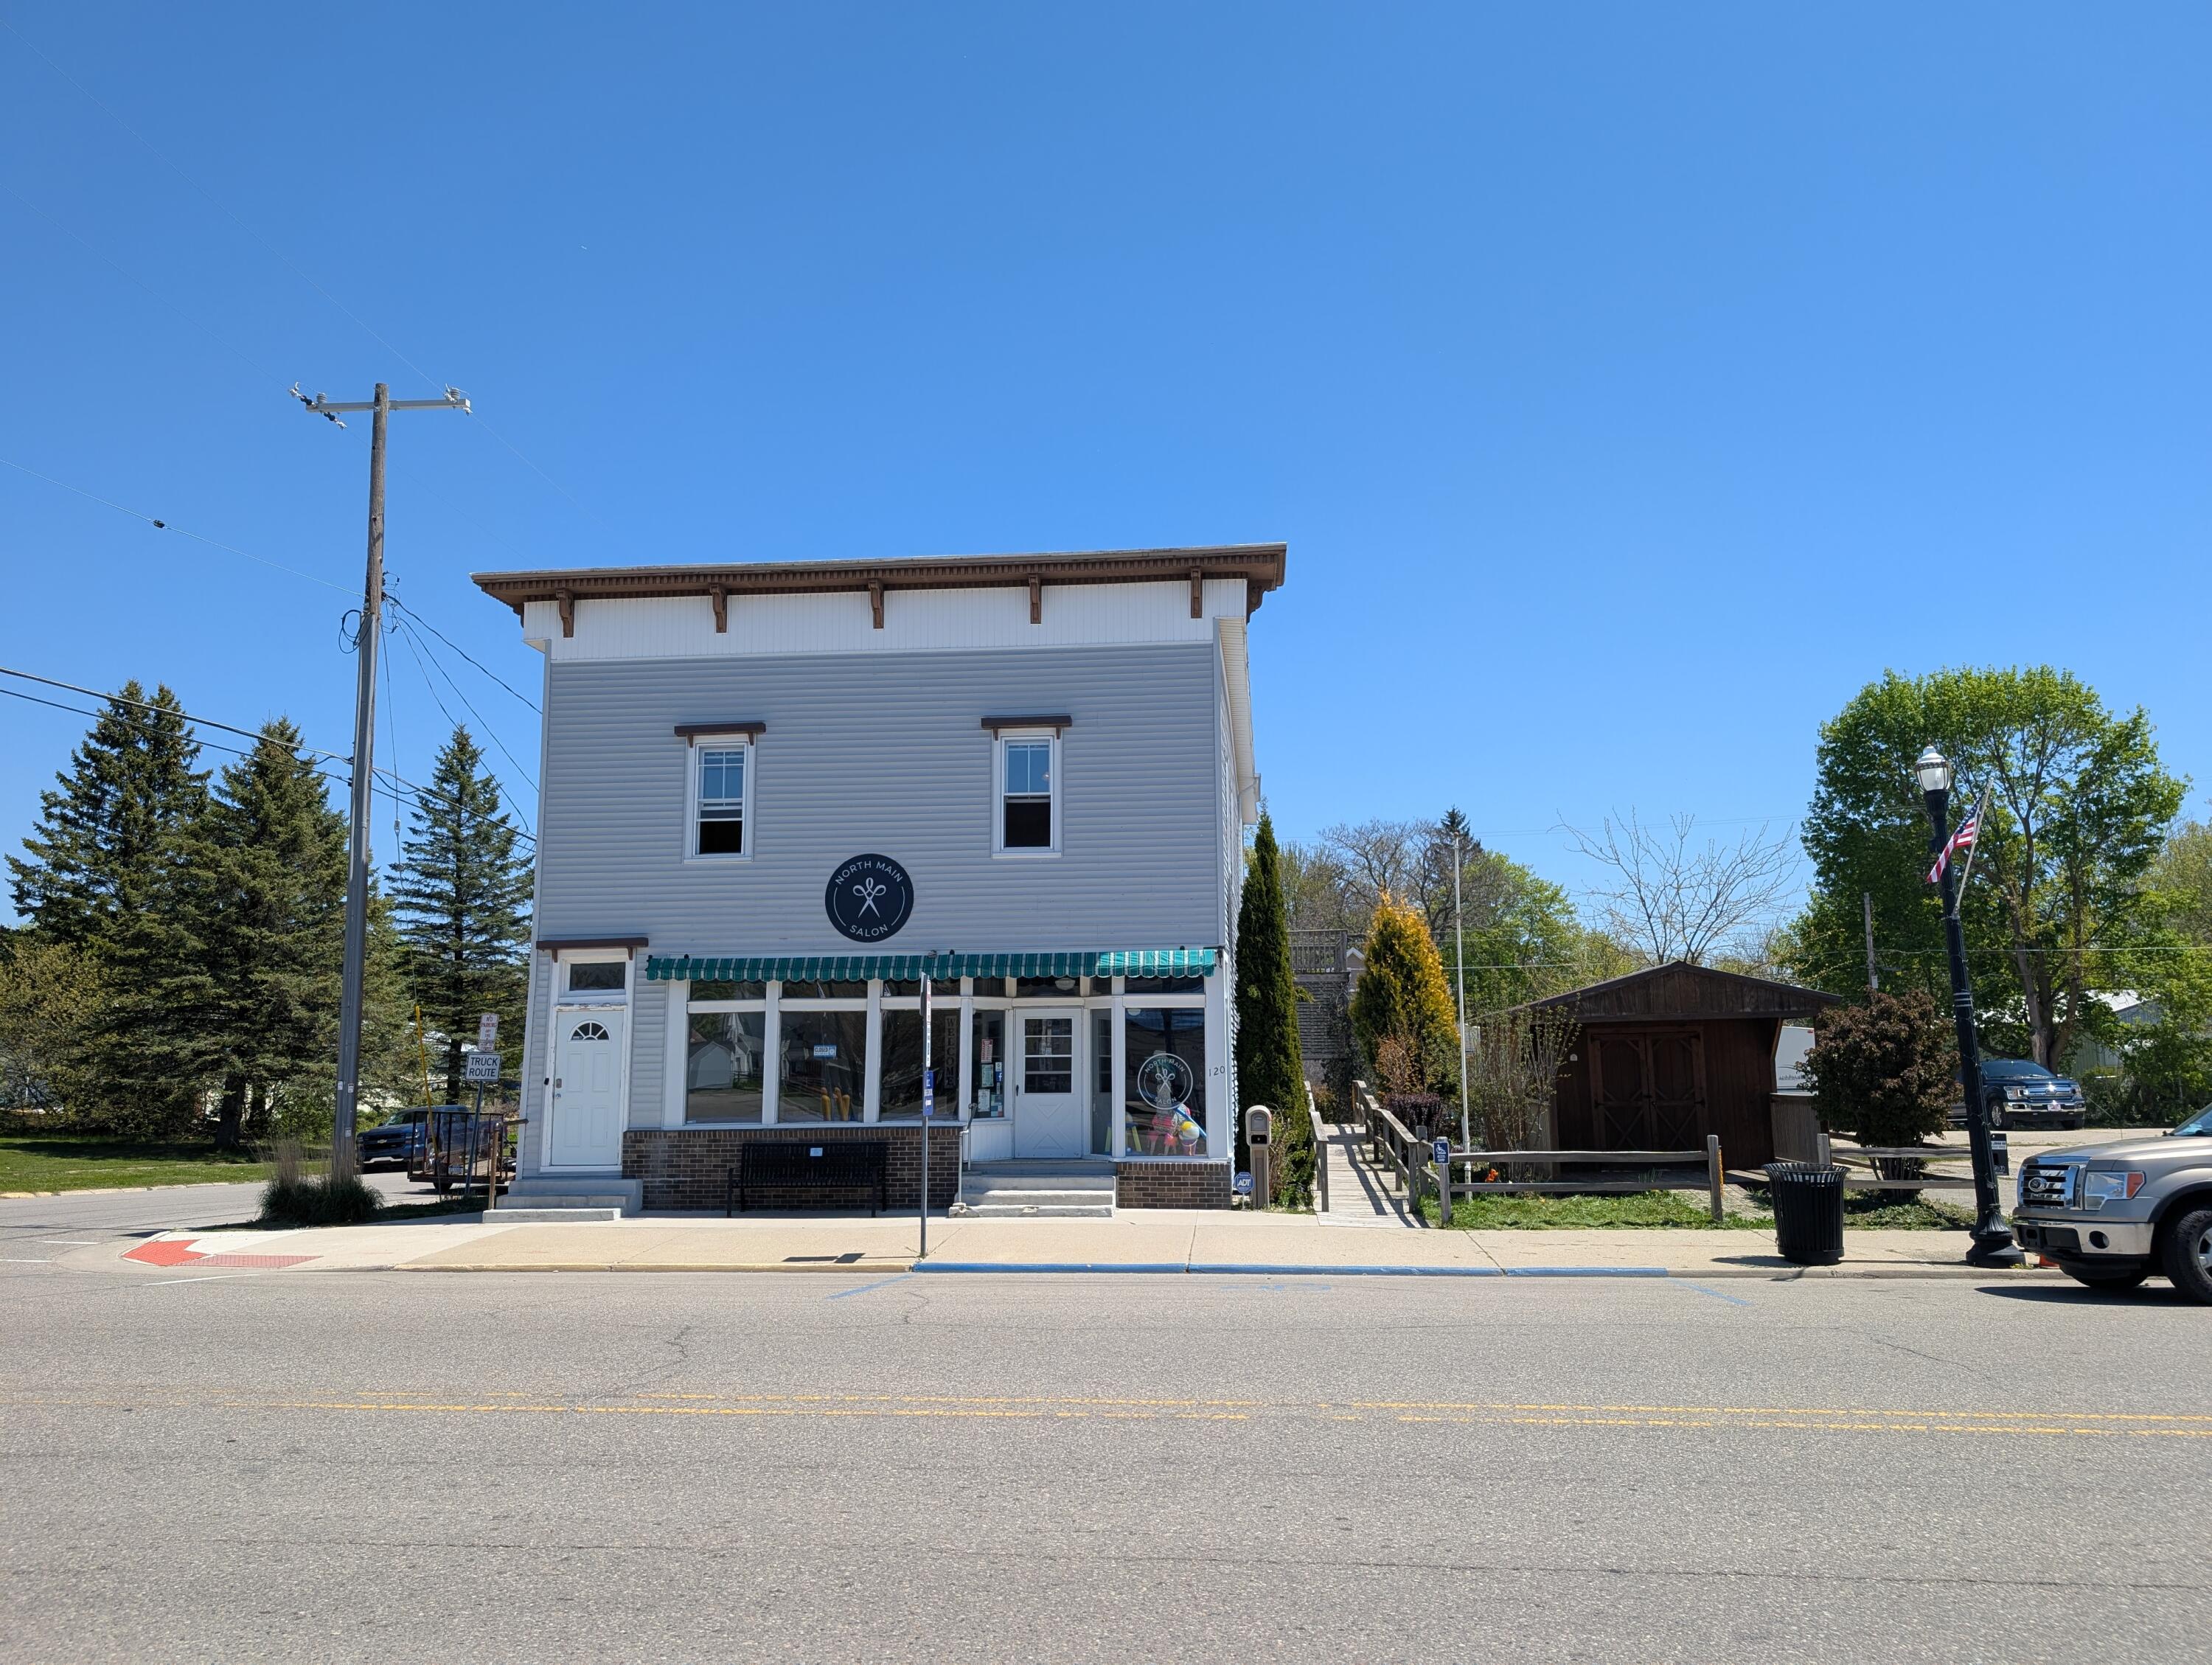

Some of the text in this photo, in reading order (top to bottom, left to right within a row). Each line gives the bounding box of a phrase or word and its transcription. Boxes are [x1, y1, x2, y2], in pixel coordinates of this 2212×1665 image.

[835, 861, 903, 885] NORTH MAIN
[849, 924, 888, 936] SALON
[946, 1018, 956, 1086] WELCOME
[470, 1057, 498, 1066] TRUCK
[1144, 1058, 1185, 1073] NORTH MAIN
[469, 1068, 496, 1077] ROUTE
[1208, 1066, 1226, 1077] 120
[1153, 1096, 1177, 1105] SALON
